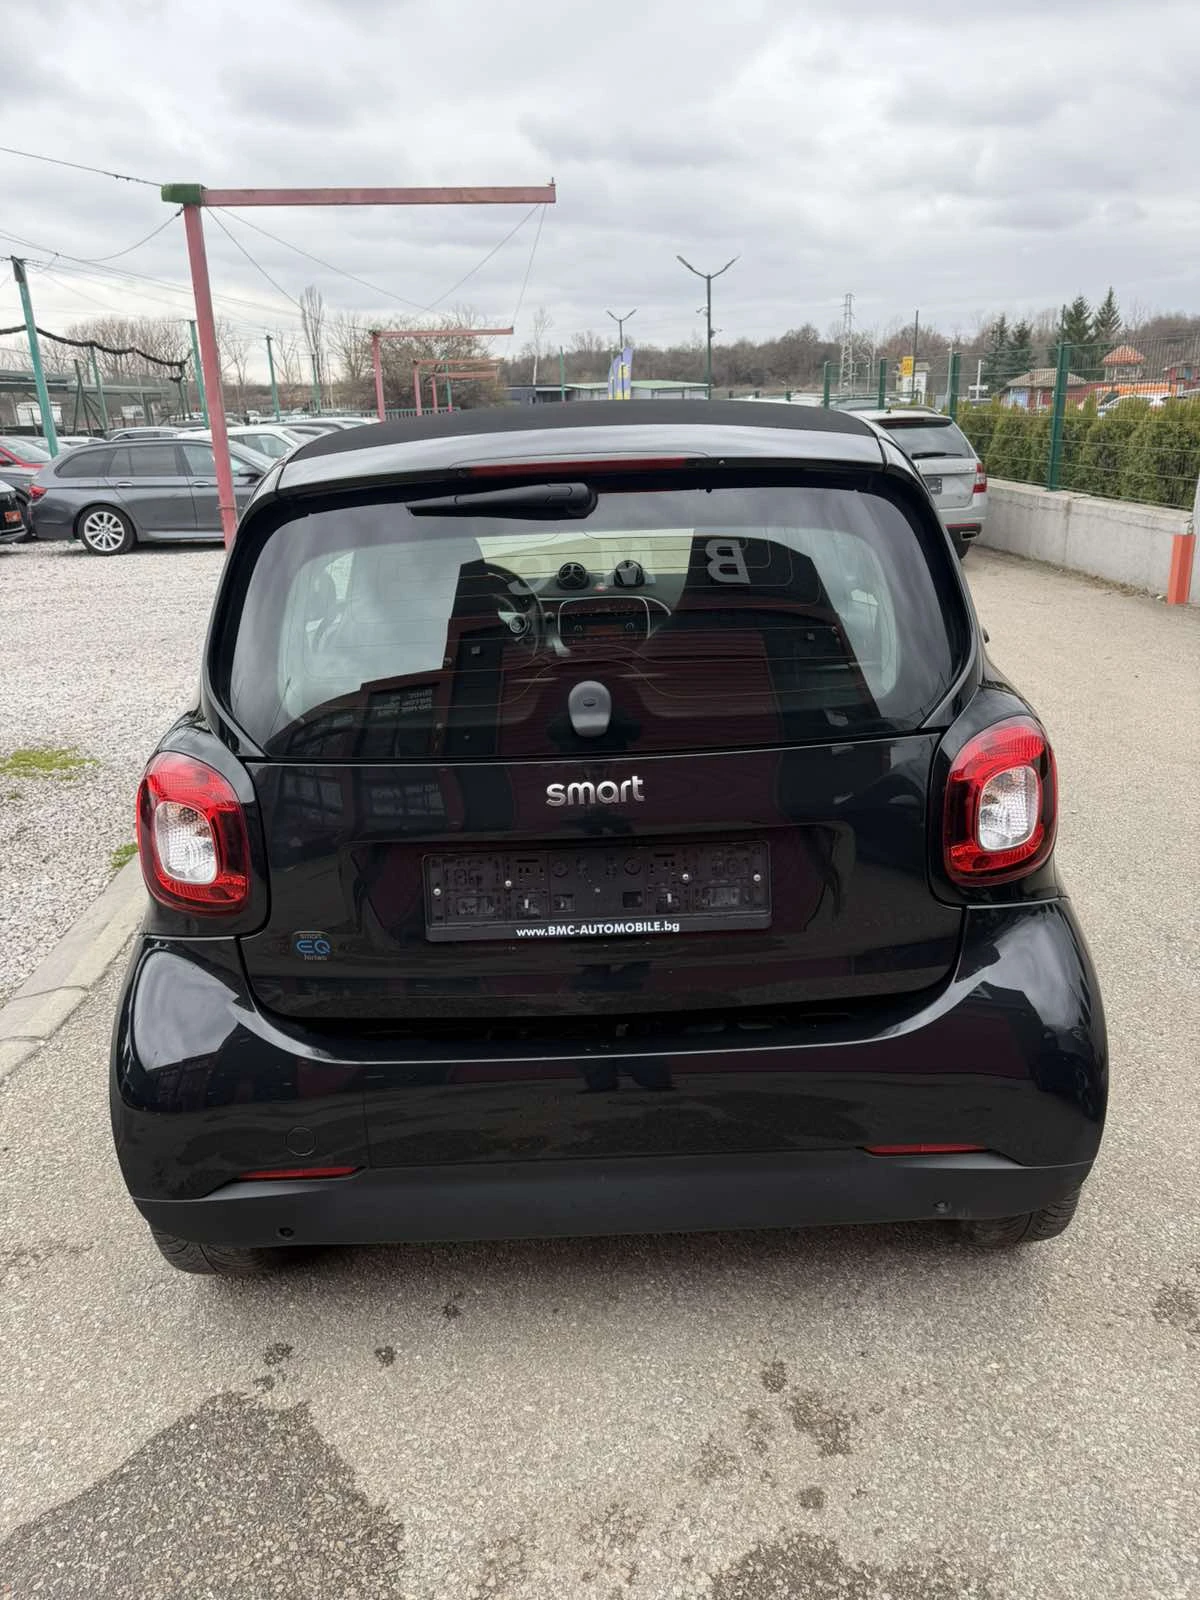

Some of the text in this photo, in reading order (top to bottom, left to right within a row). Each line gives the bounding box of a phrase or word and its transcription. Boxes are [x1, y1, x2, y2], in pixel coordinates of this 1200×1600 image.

[546, 775, 645, 806] smart
[516, 921, 680, 937] www.BMC-AUTOMOBILE.bg
[297, 940, 331, 954] EQ
